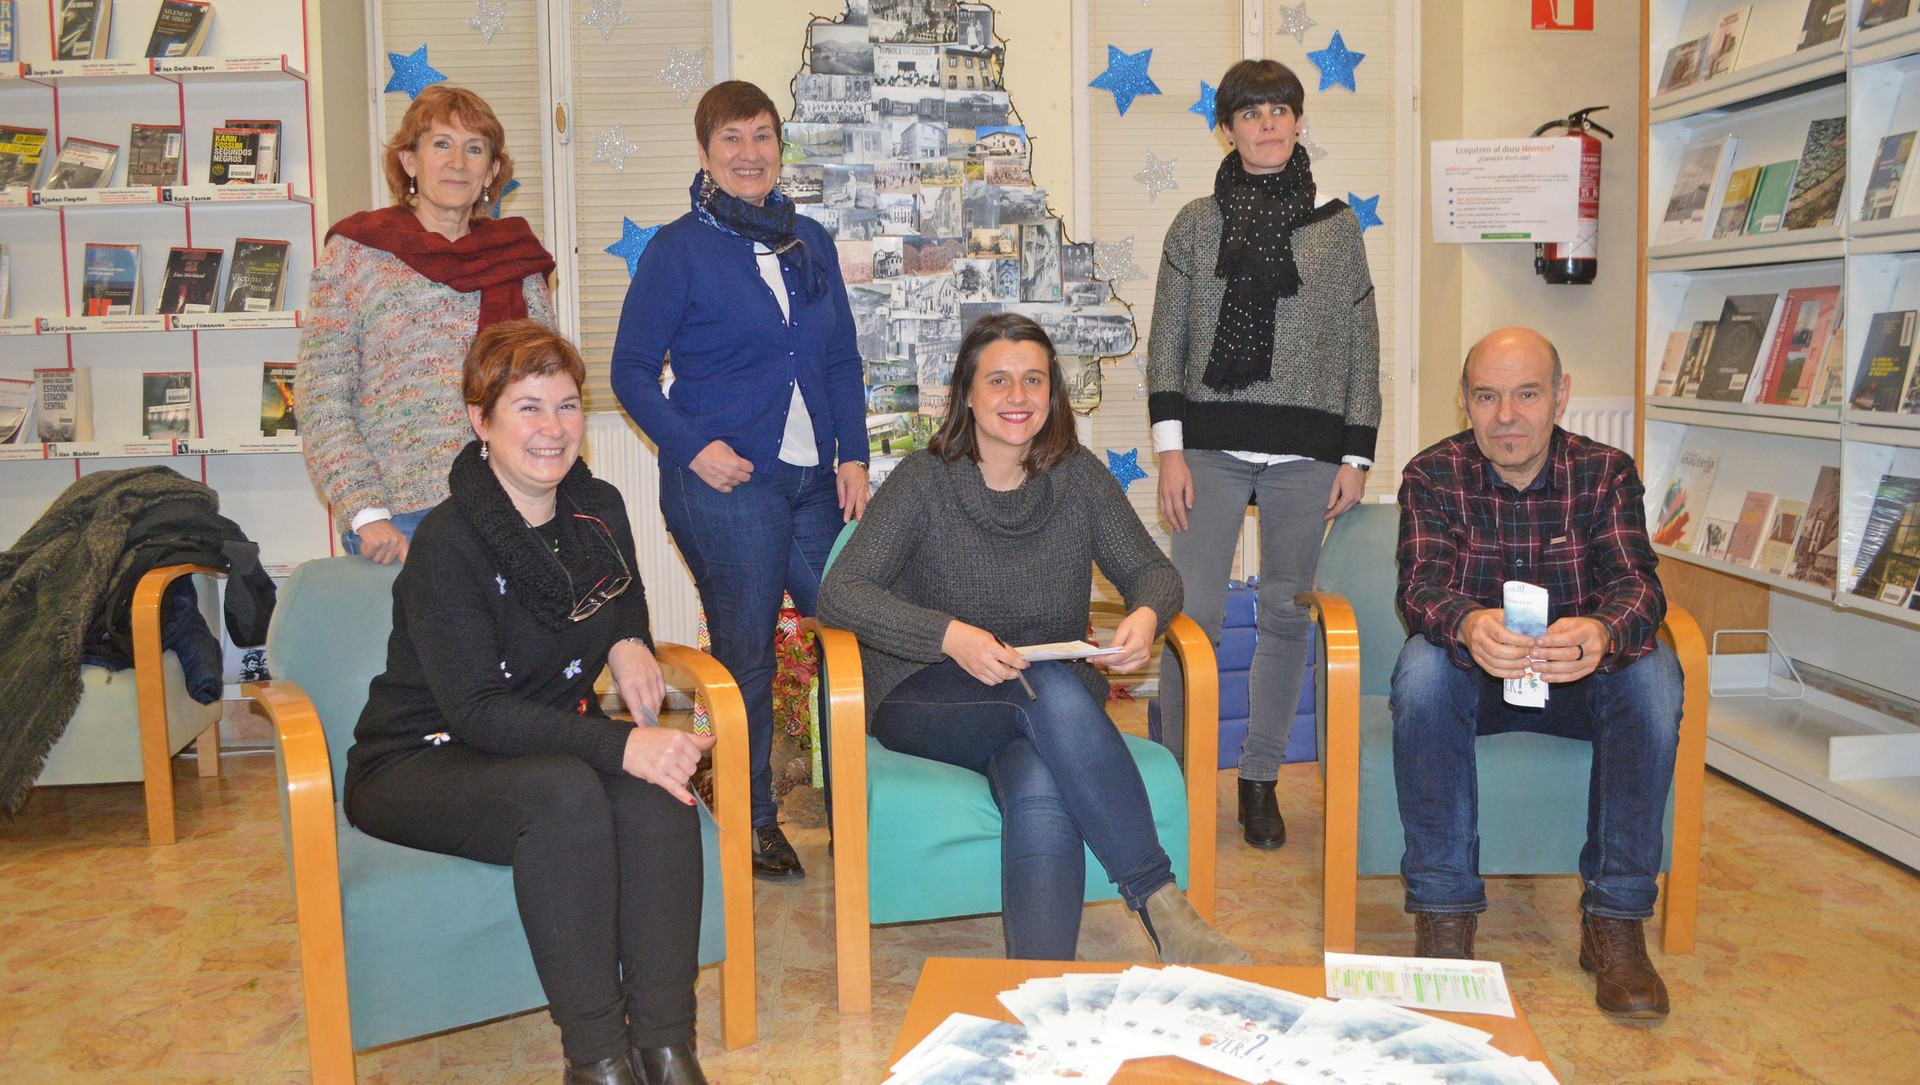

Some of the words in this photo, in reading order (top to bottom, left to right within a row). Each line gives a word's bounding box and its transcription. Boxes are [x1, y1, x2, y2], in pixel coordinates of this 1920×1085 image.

[163, 8, 192, 17] SILENCIO
[215, 135, 238, 143] KARIN
[214, 148, 253, 156] SEGUNDOS
[1456, 146, 1492, 156] Ezagutzen
[1502, 145, 1520, 153] duzu
[213, 155, 243, 163] NEGROS
[43, 385, 73, 393] ESTOCOLMO
[43, 393, 68, 401] ESTACIÓN
[44, 402, 66, 410] CENTRAL
